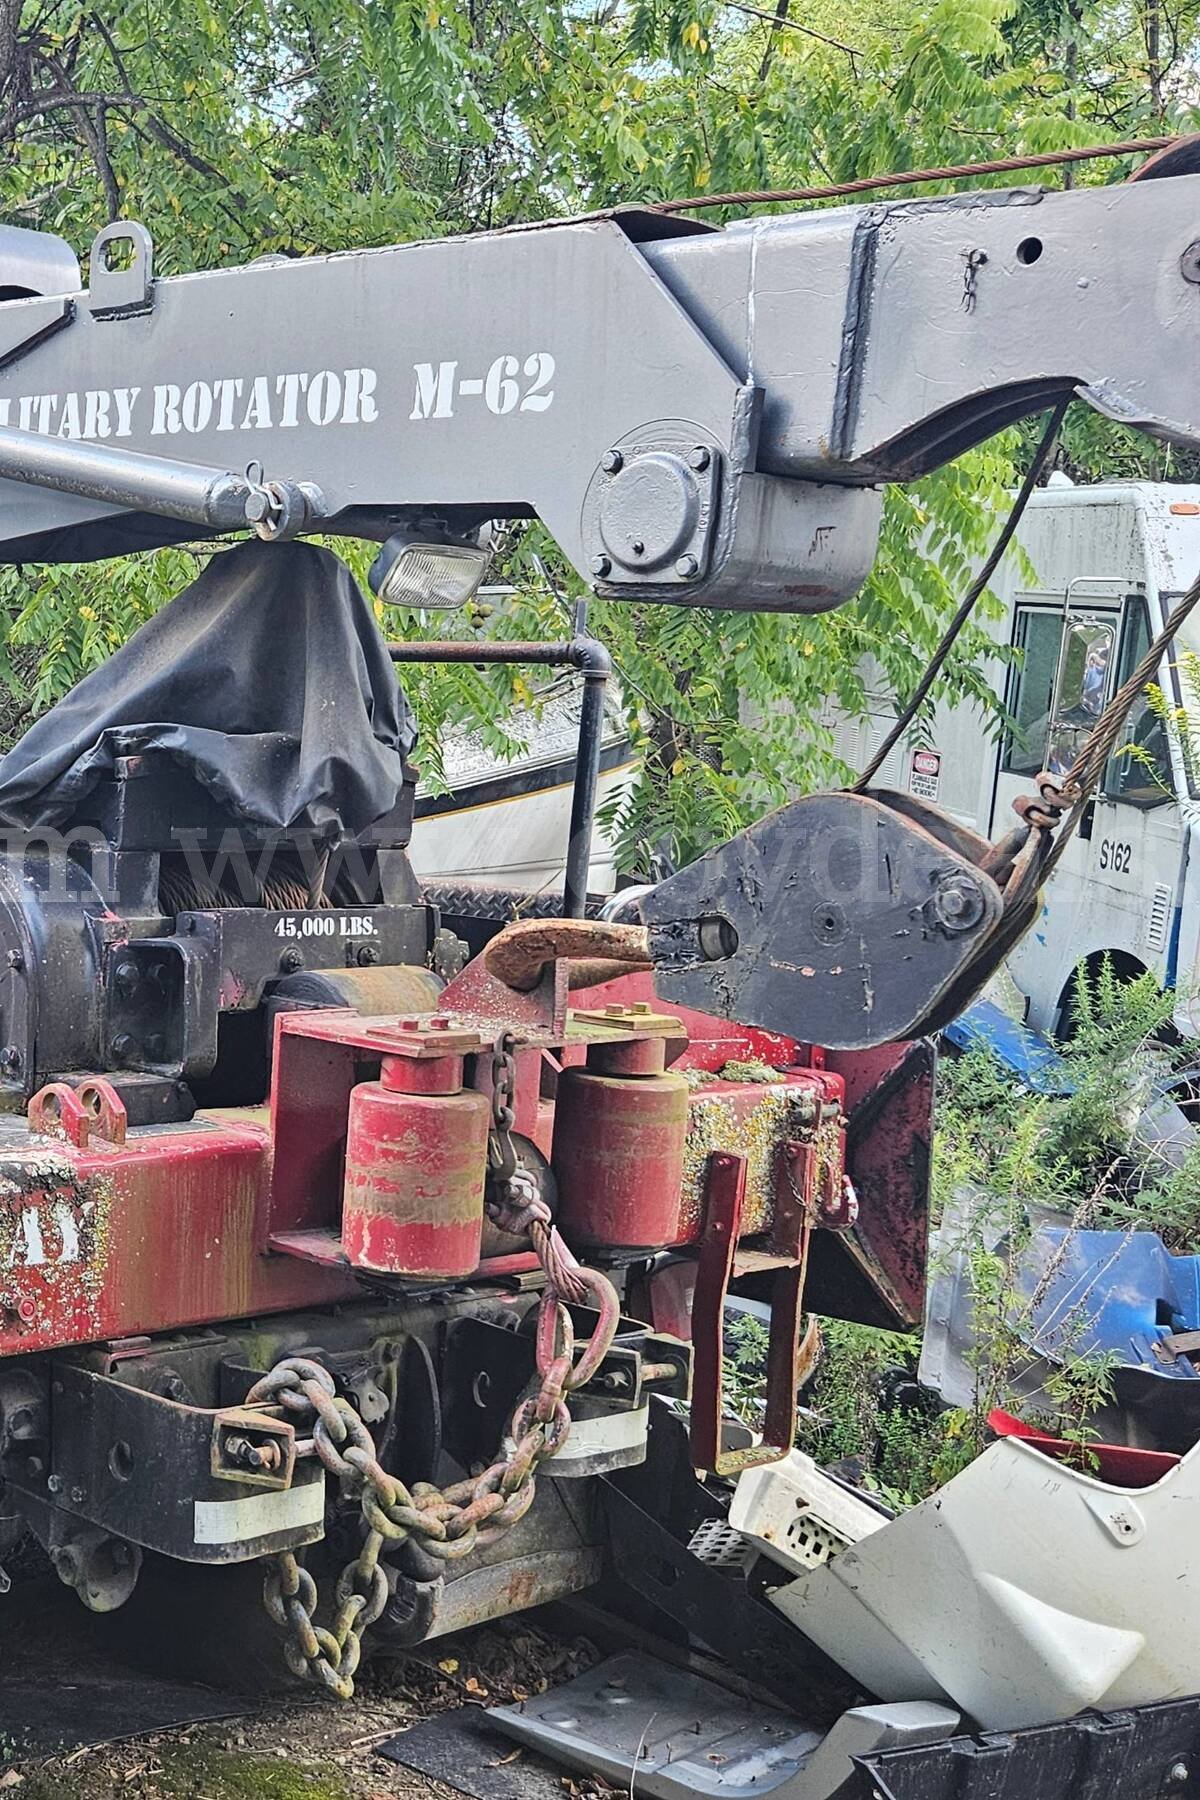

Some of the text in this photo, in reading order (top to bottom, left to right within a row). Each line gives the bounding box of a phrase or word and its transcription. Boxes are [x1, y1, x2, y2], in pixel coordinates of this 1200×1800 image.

[150, 367, 379, 436] ROTATOR
[409, 352, 556, 421] M-62
[1100, 839, 1132, 874] S162
[274, 916, 378, 939] 45,000 LBS.
